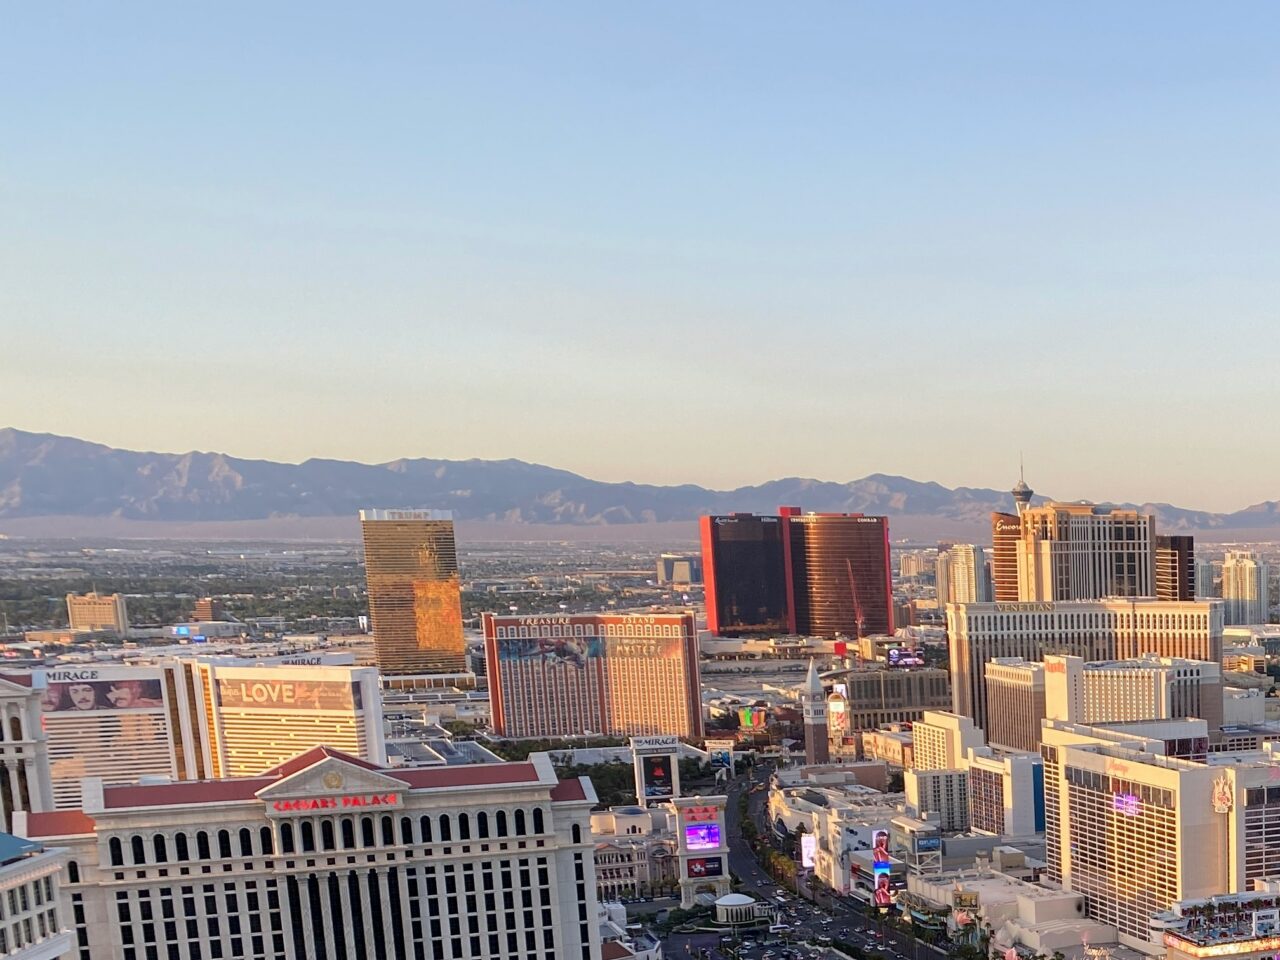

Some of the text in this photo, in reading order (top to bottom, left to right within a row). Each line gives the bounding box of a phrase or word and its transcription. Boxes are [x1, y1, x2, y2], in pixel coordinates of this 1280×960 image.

[997, 603, 1053, 612] VENETIAN
[519, 616, 656, 626] TREASURE ISLAND
[291, 657, 322, 665] MIRAGE
[46, 670, 99, 681] MIRAGE
[240, 682, 295, 703] LOVE
[641, 738, 677, 746] MIRAGE
[273, 793, 397, 812] CAESARS PALACE
